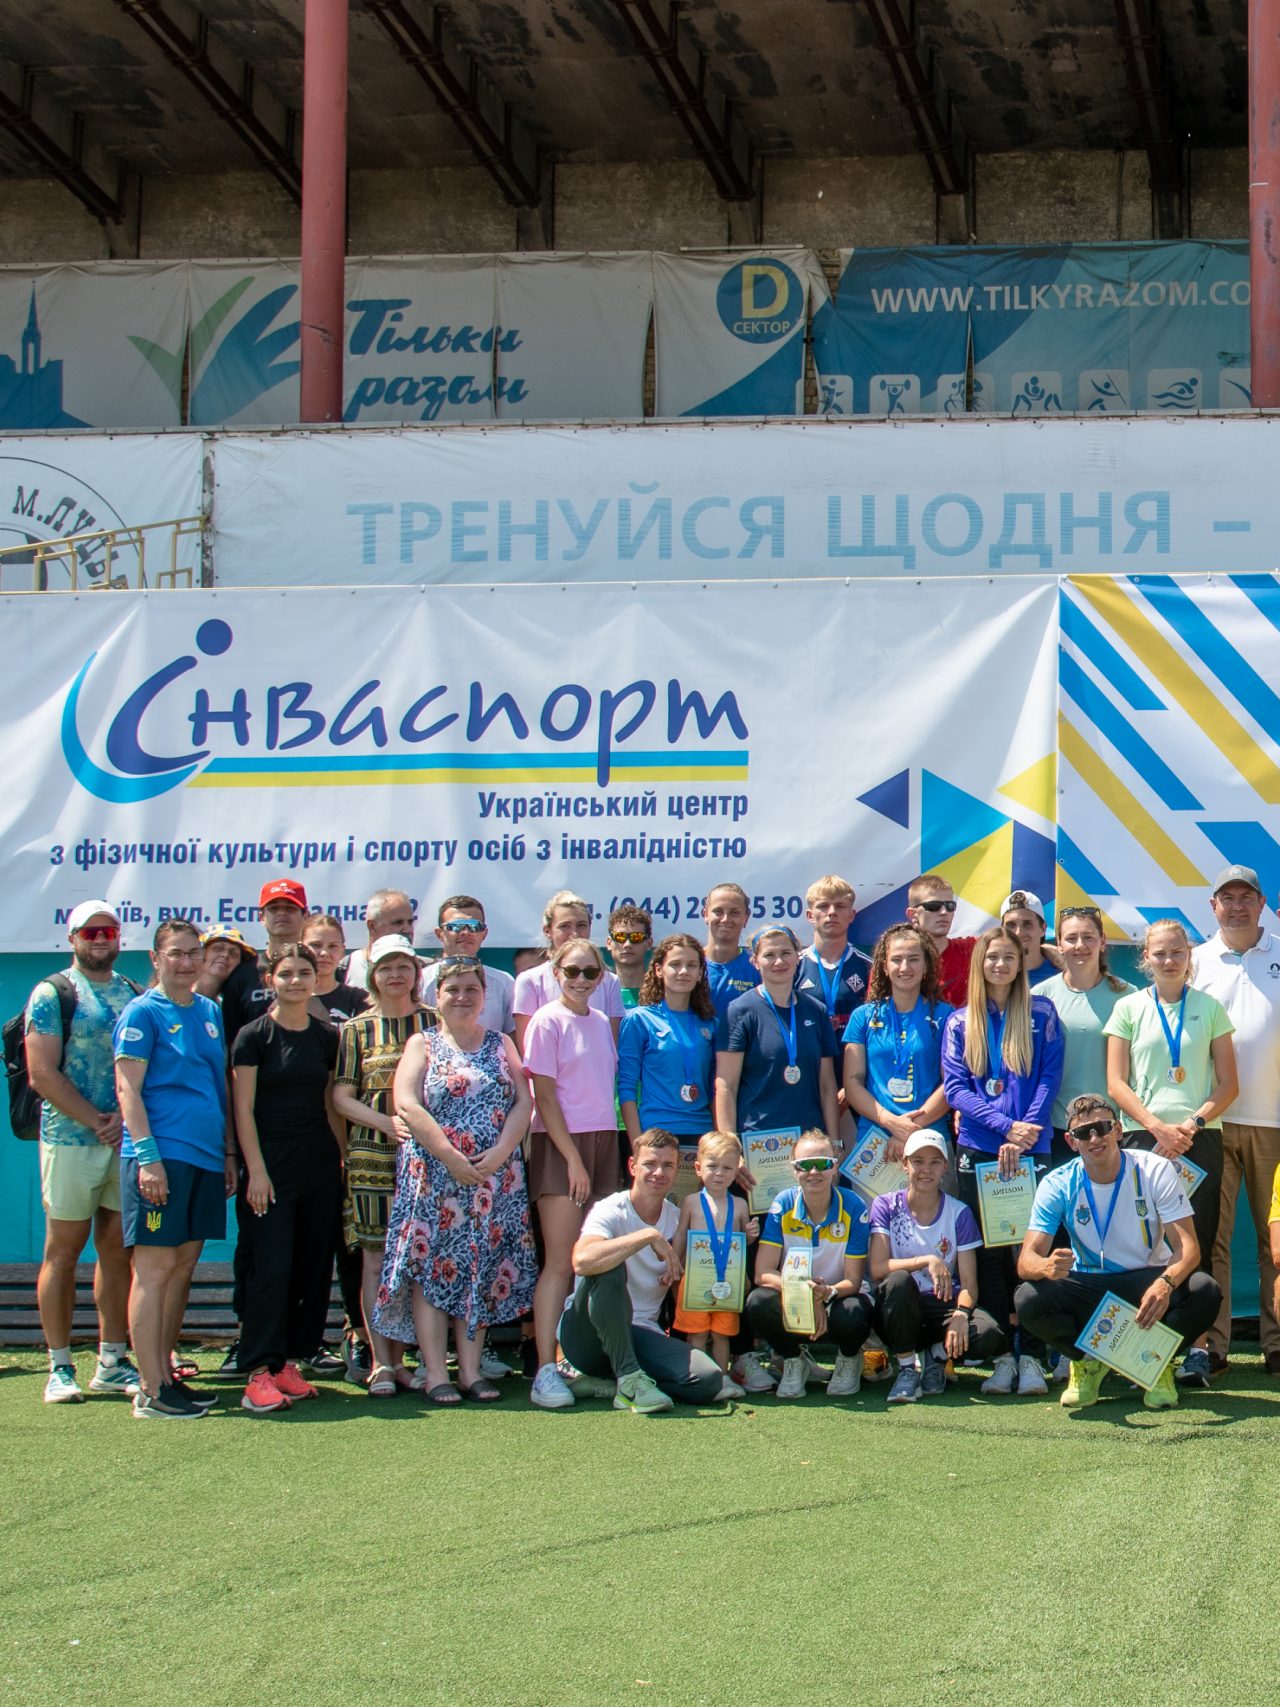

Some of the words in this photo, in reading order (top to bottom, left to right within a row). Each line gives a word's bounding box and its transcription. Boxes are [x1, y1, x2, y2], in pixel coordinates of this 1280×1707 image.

[346, 298, 524, 356] Тільки
[733, 321, 791, 335] СЕКТОР
[346, 480, 786, 566] ТРЕНУЙСЯ
[826, 489, 1173, 570] ЩОДНЯ
[478, 790, 657, 824] Український
[667, 793, 749, 822] центр
[50, 845, 64, 866] з
[74, 837, 201, 872] фізичної
[208, 840, 338, 869] культури
[346, 835, 355, 862] і
[364, 838, 459, 867] спорту
[467, 832, 527, 862] осіб
[536, 840, 552, 861] з
[560, 831, 748, 863] інвалідністю
[772, 895, 803, 919] 30
